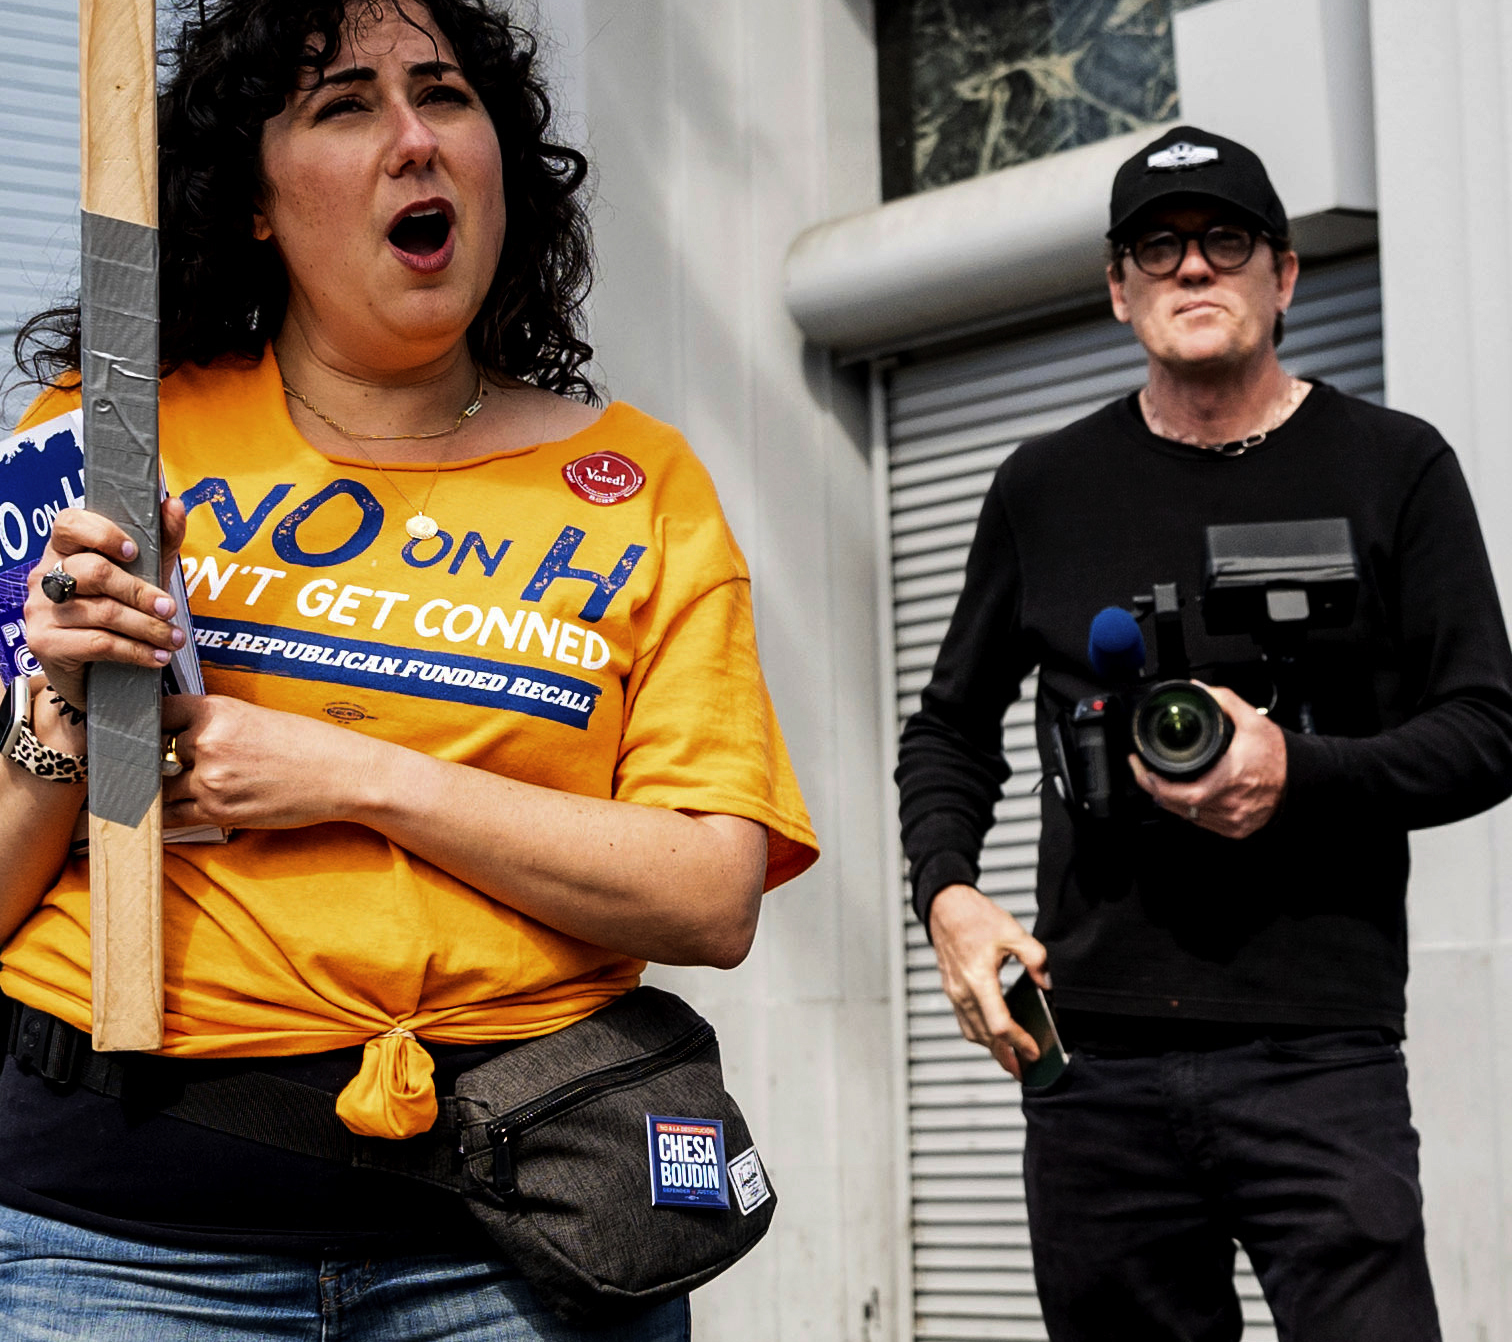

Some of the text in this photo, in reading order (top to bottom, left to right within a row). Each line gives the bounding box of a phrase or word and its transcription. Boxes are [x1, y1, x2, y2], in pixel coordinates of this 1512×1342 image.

[586, 467, 626, 486] Voted!
[602, 460, 610, 472] I
[185, 477, 385, 568] NO
[401, 530, 514, 577] ON
[521, 525, 648, 623] H
[296, 578, 410, 631] GET
[414, 598, 611, 671] CONNED
[192, 628, 594, 712] HE REPUBLICAN FUNDED RECALL
[658, 1134, 717, 1164] CHESA
[660, 1162, 720, 1189] BOUDIN
